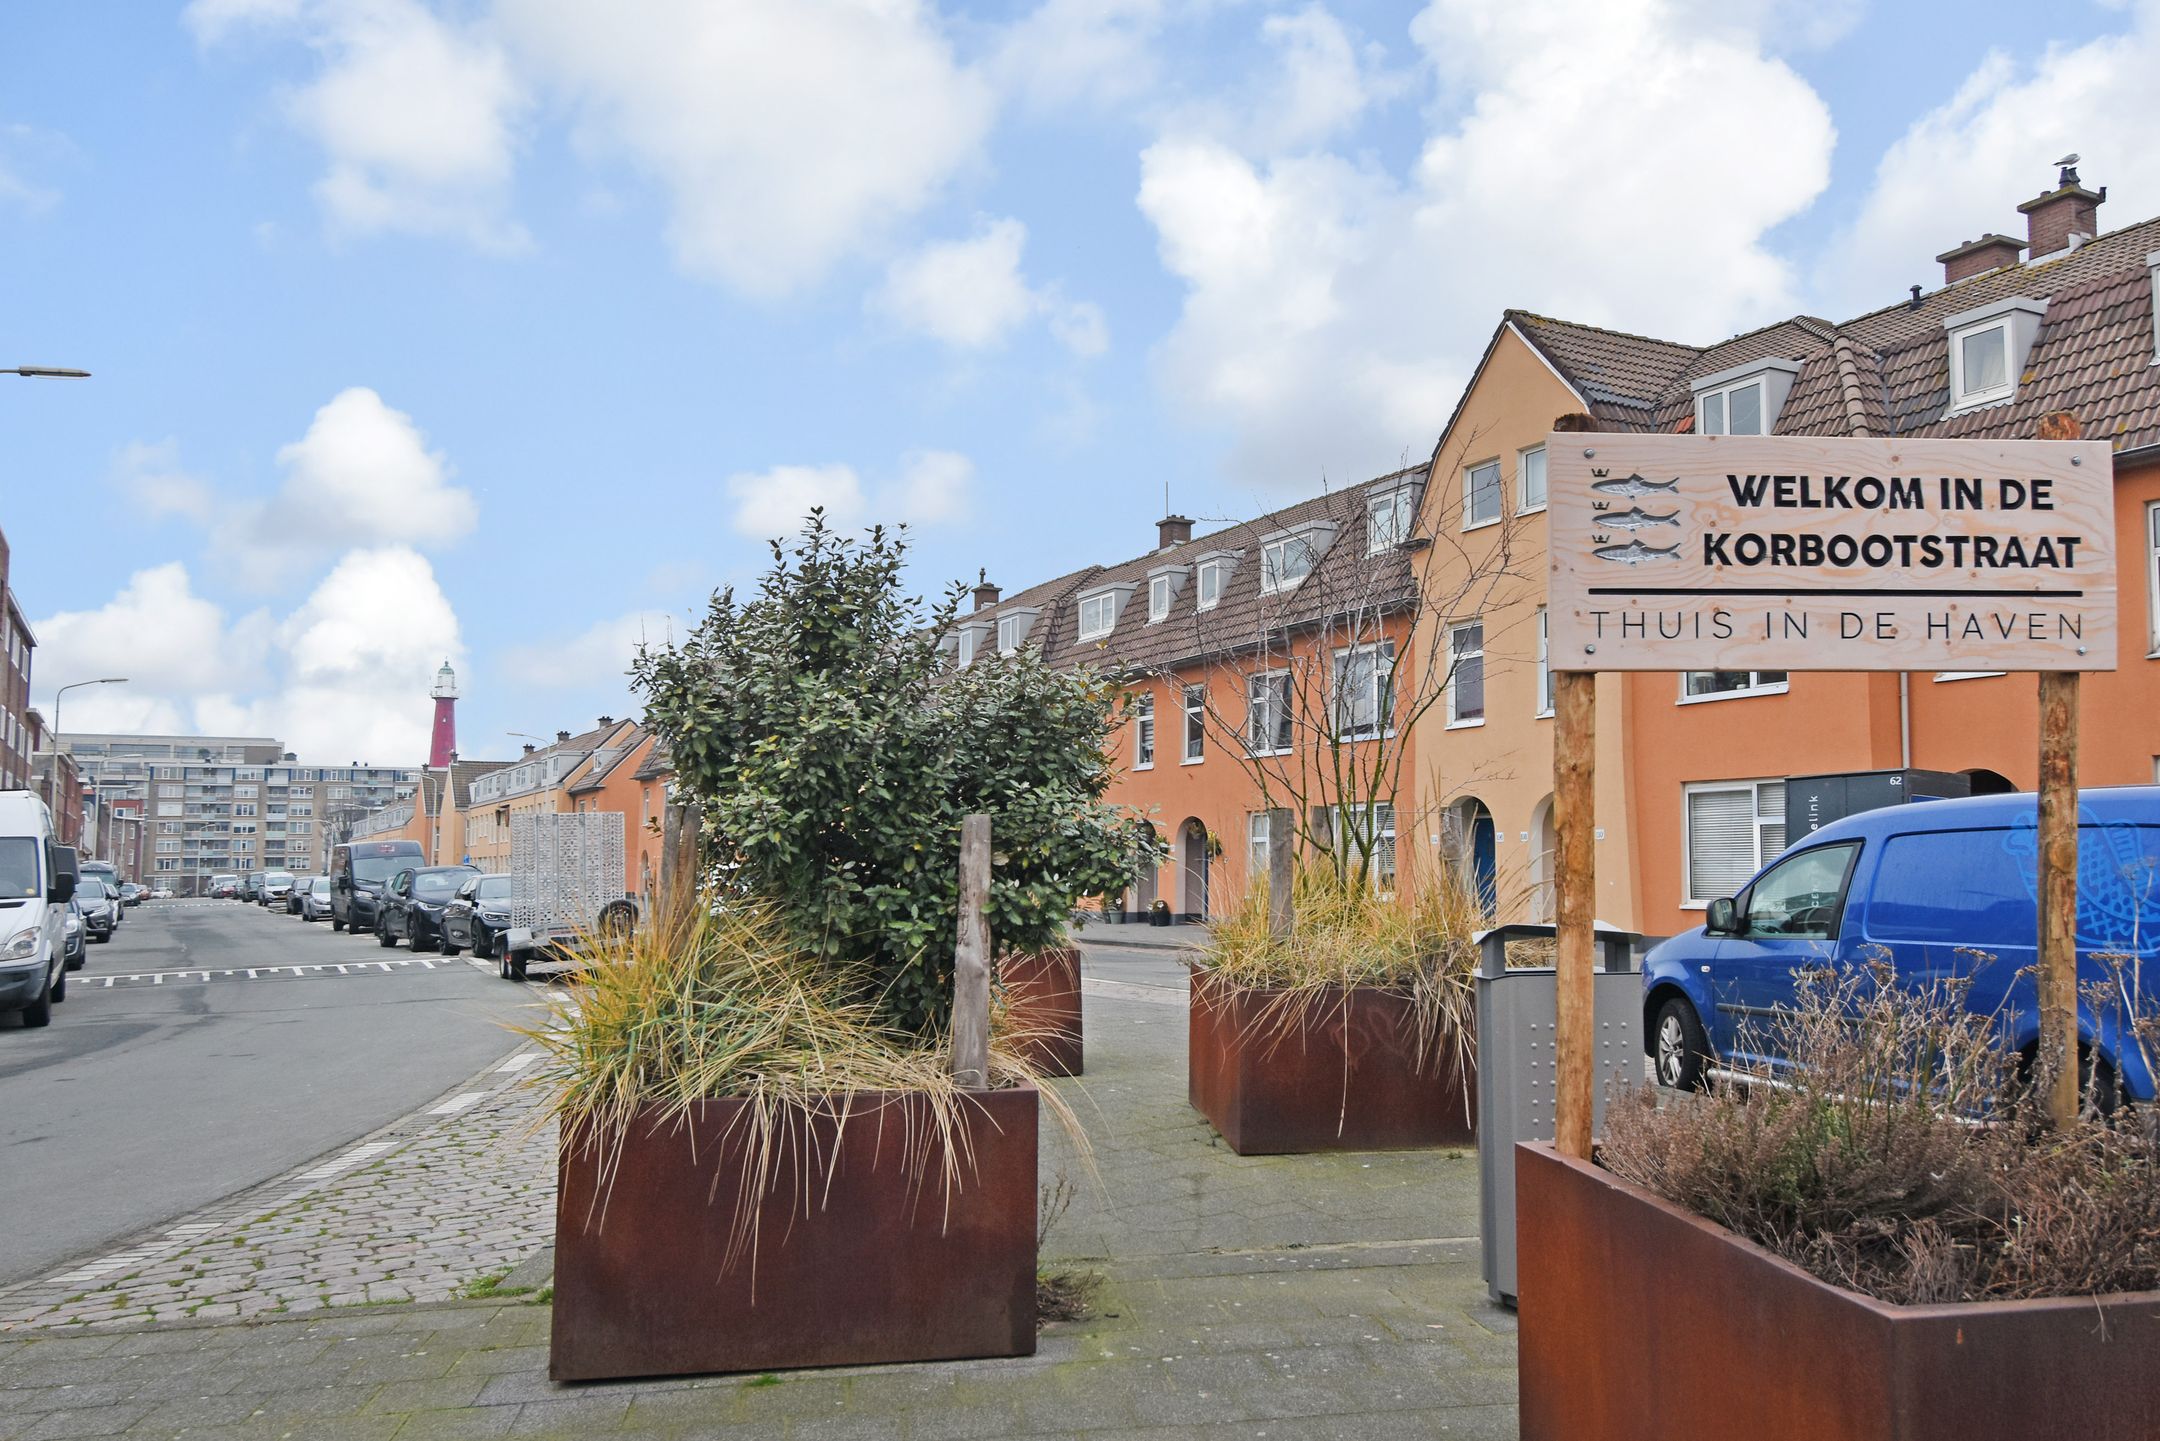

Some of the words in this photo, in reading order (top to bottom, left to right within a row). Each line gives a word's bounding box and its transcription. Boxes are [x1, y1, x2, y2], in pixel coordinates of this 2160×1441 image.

[1726, 474, 1925, 511] WELKOM
[1939, 477, 1983, 511] IN
[1999, 478, 2054, 511] DE
[1703, 532, 2082, 569] KORBOOTSTRAAT
[1589, 611, 1733, 639] THUIS
[1766, 611, 1807, 639] IN
[1840, 612, 1896, 640] DE
[1927, 612, 2083, 640] HAVEN
[1889, 776, 1902, 786] 62
